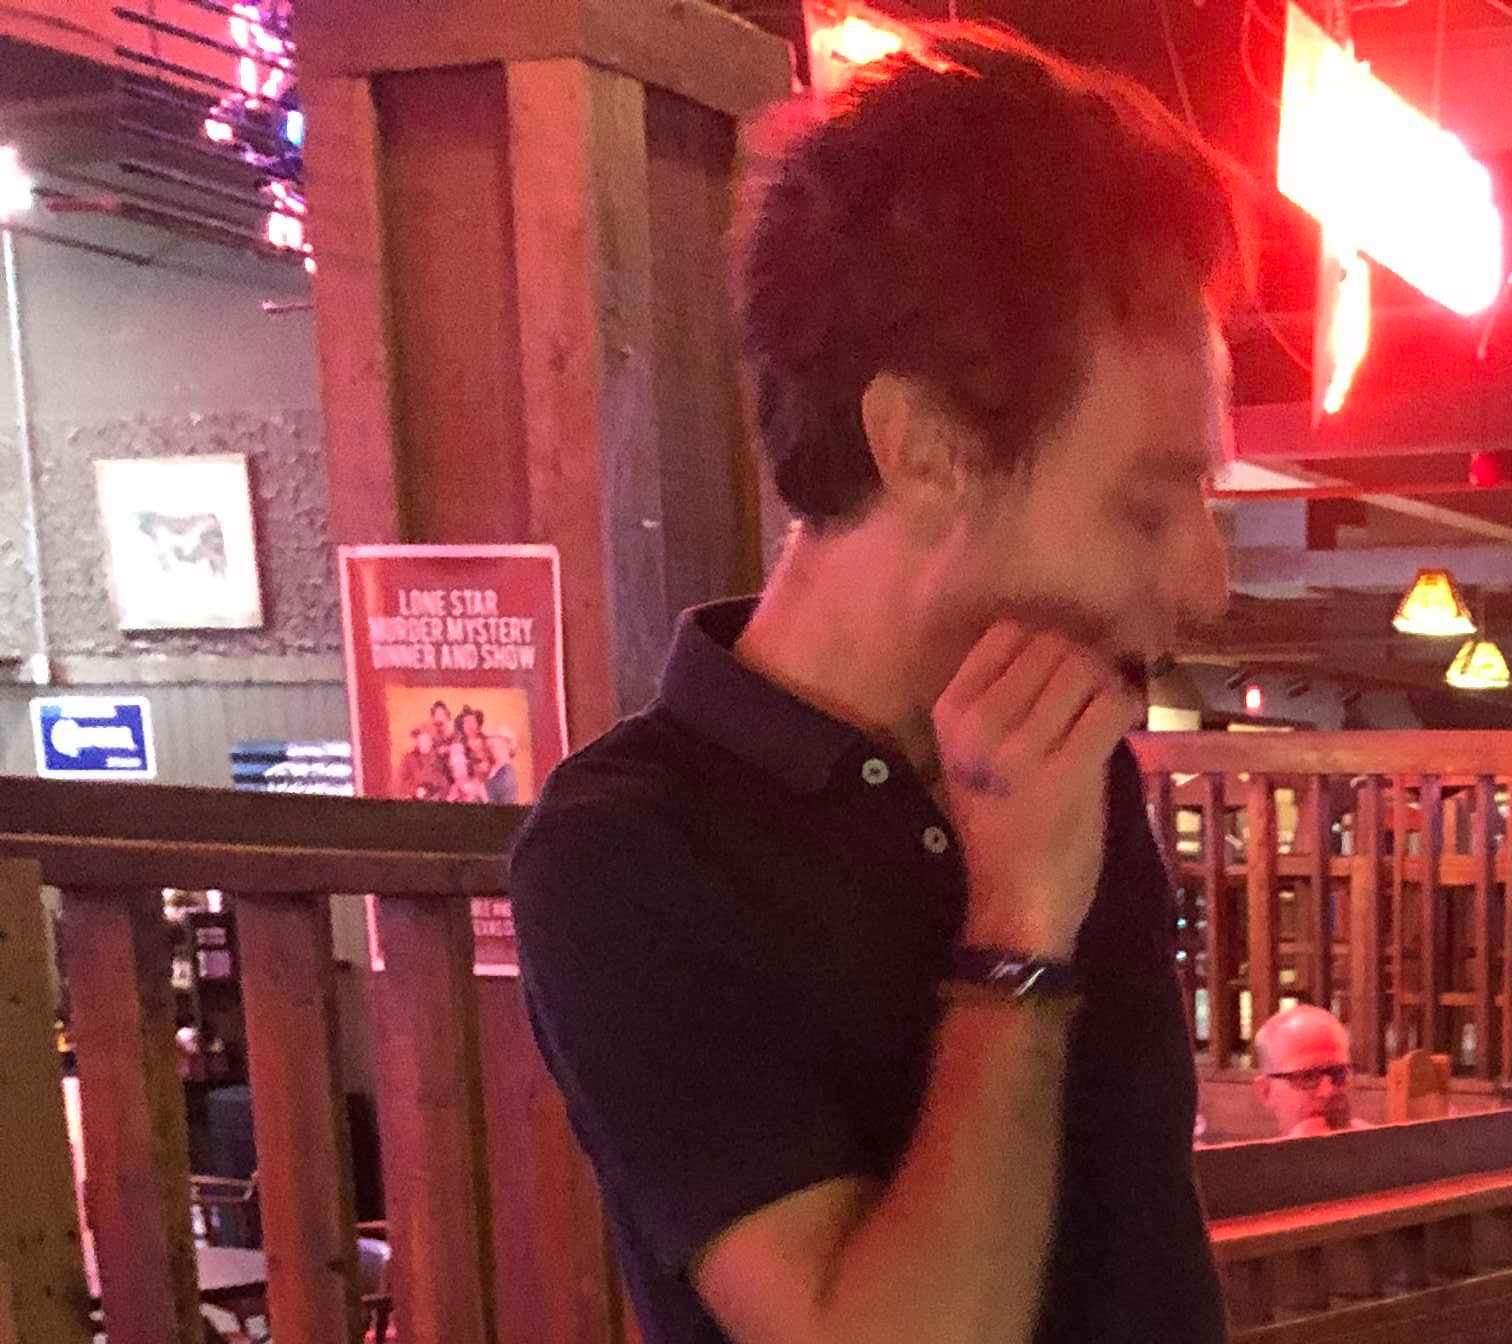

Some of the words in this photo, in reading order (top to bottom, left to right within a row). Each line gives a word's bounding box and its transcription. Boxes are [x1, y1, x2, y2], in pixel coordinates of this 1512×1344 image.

[398, 589, 448, 616] LONE
[450, 589, 499, 616] STAR
[446, 617, 534, 644] MYSTERY
[440, 644, 479, 670] AND
